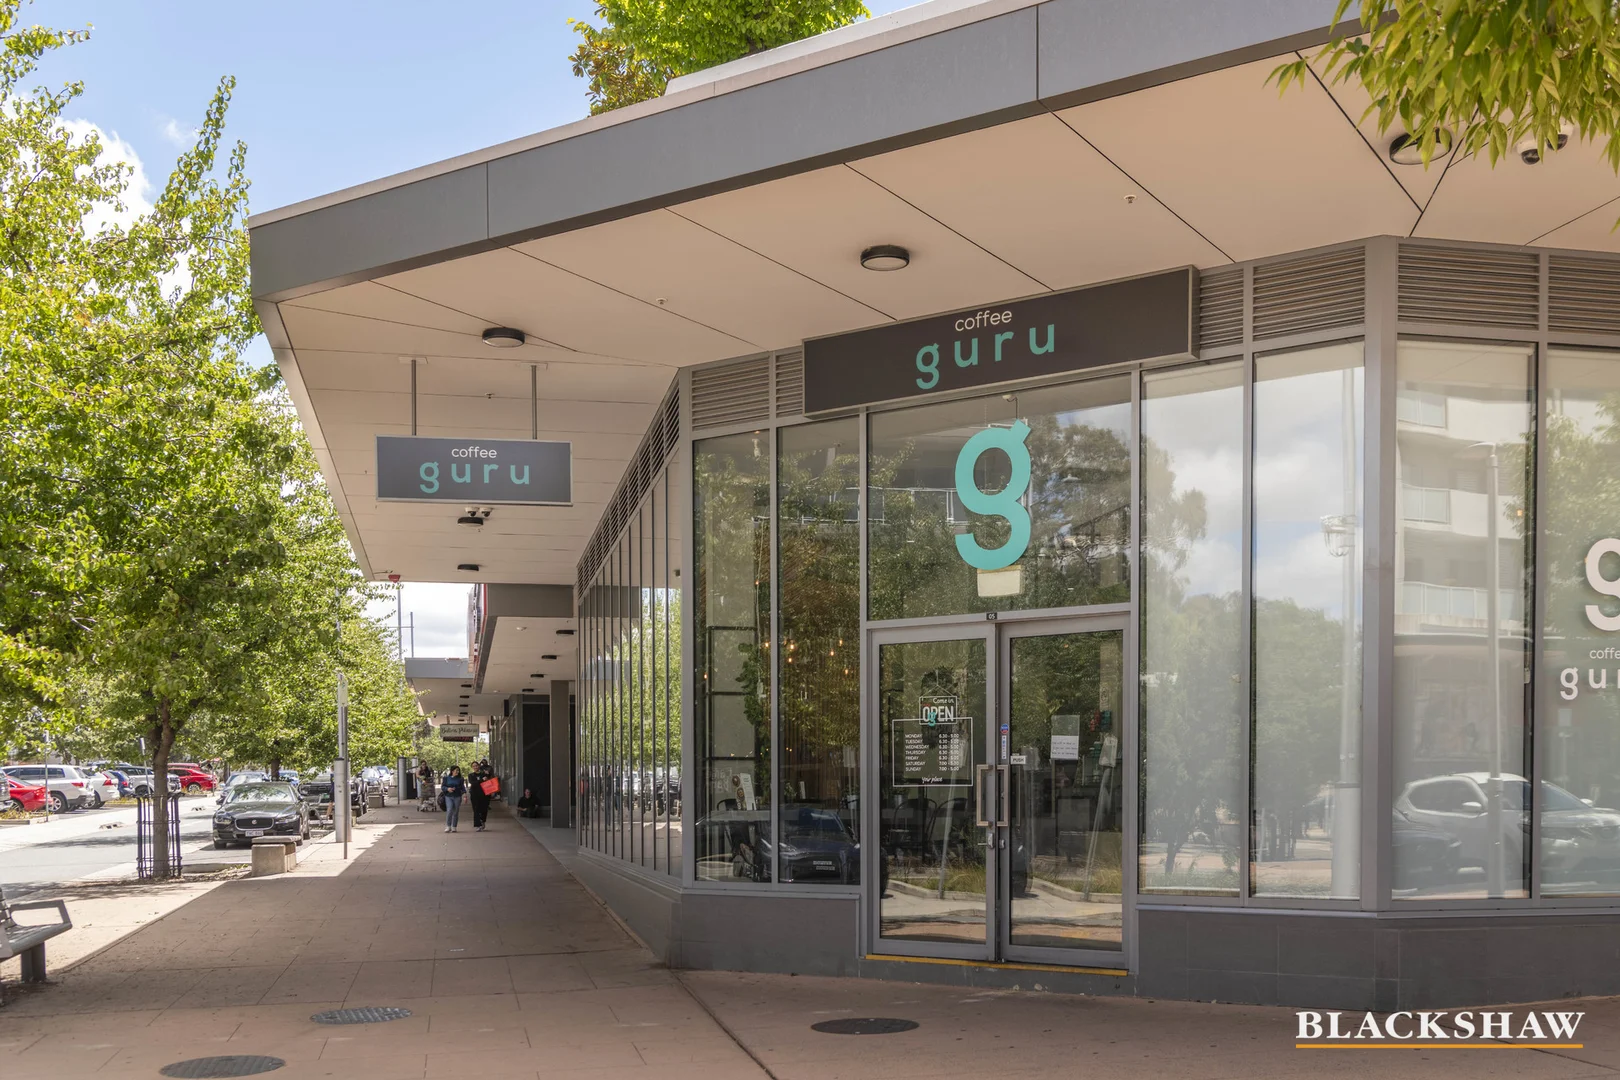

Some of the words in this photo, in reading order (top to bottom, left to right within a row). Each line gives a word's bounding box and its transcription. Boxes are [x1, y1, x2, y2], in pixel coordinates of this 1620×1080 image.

[955, 310, 1012, 332] coffee
[916, 324, 1055, 390] guru
[451, 446, 497, 458] coffee
[419, 461, 530, 493] guru
[955, 418, 1031, 571] g
[1560, 667, 1620, 700] gu
[922, 706, 954, 722] OPEN
